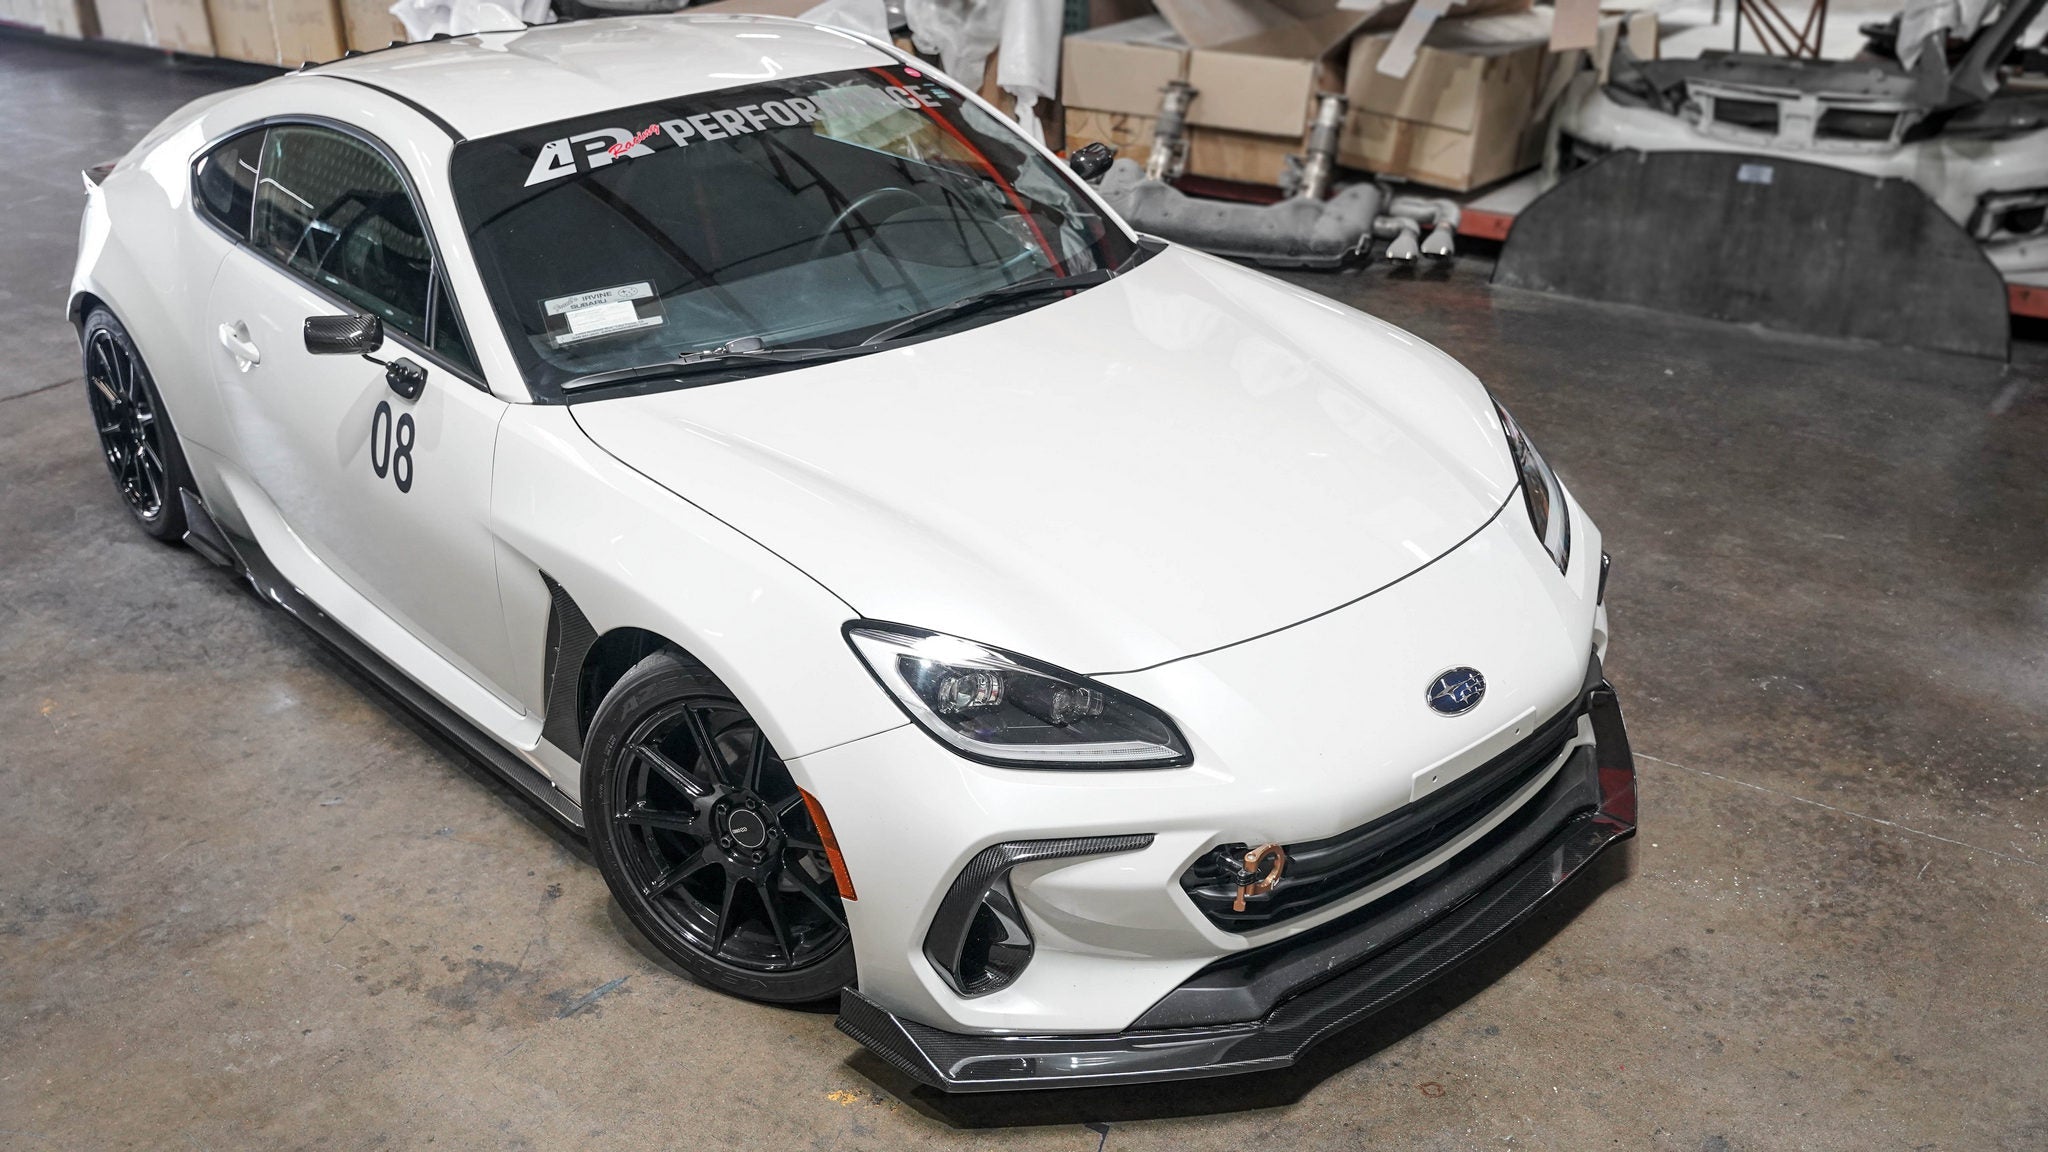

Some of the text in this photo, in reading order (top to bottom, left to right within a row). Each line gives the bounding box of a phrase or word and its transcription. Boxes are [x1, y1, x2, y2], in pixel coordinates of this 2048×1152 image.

[659, 84, 942, 147] PERFORCE
[608, 123, 661, 160] Racing
[570, 299, 607, 309] SUBARU
[582, 291, 612, 301] IRVINE
[371, 400, 415, 494] 08
